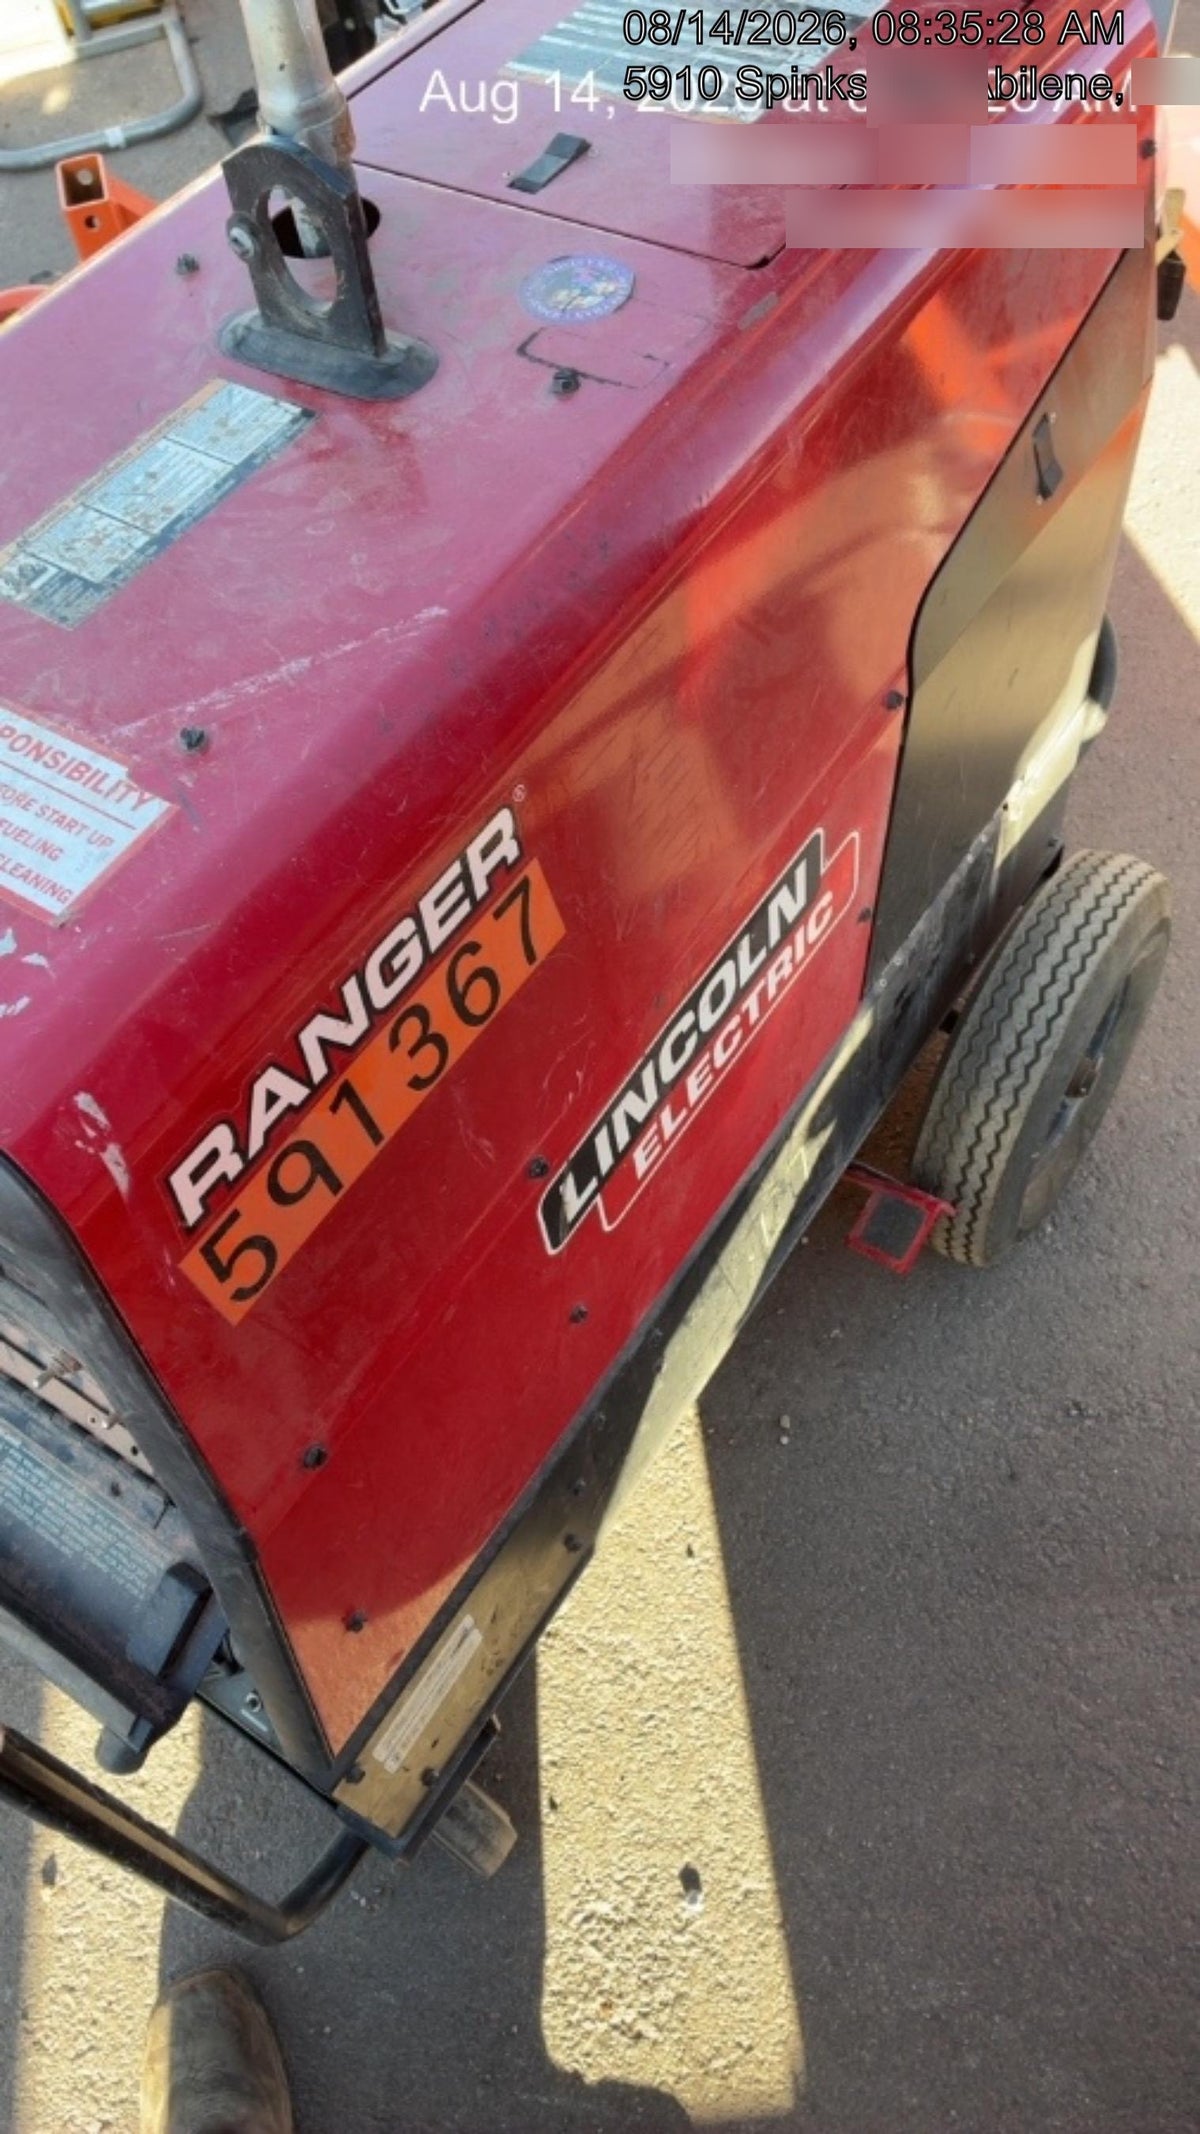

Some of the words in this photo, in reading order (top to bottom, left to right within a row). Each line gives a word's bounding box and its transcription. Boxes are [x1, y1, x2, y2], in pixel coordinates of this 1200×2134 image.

[35, 797, 90, 837] START
[87, 829, 115, 848] UP
[166, 805, 523, 1229] RANGER
[198, 874, 538, 1302] 591367
[560, 857, 808, 1224] LINCOLN
[632, 890, 833, 1180] ELECTRIC
